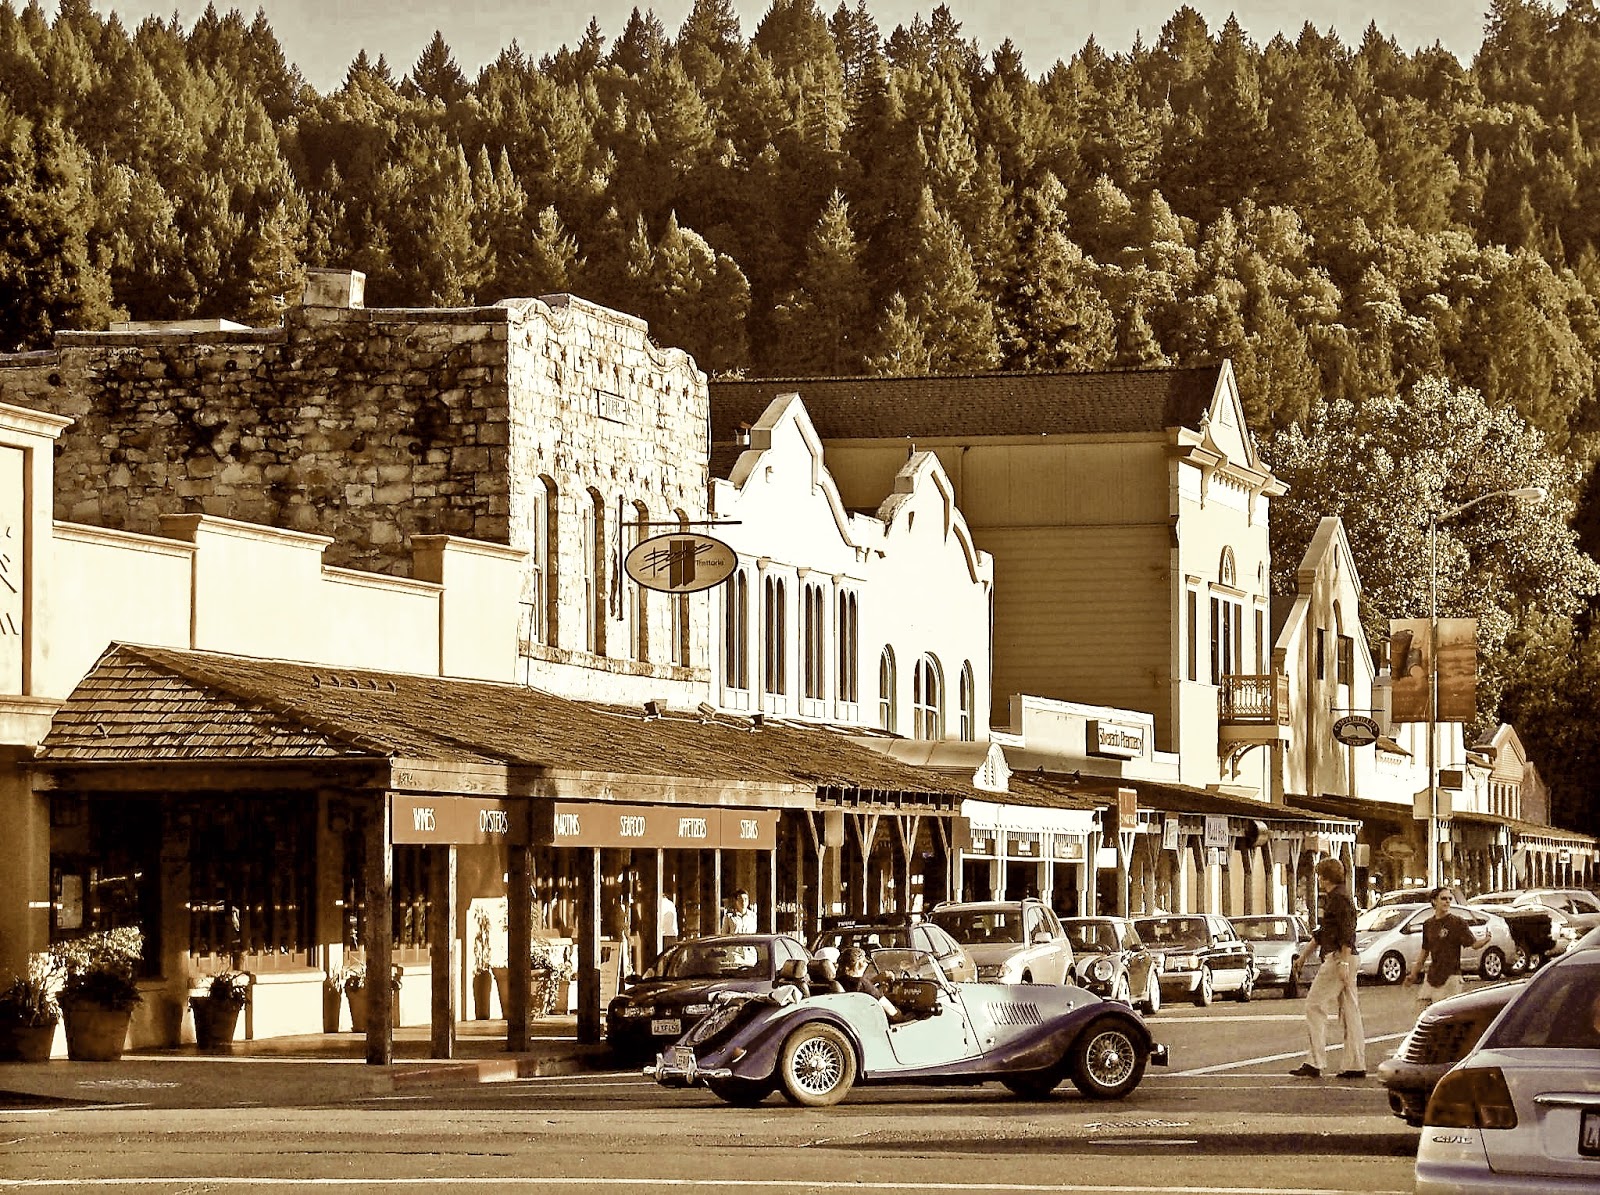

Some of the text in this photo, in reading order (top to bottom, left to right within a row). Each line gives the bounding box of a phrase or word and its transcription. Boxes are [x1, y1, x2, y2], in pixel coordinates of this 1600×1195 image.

[1120, 730, 1142, 754] Pharmacy
[412, 807, 436, 831] WINES
[479, 809, 508, 835] OYSTERS
[619, 815, 646, 837] SEAFOOD
[739, 819, 760, 839] STEAKS
[1432, 1135, 1473, 1144] CIVIC
